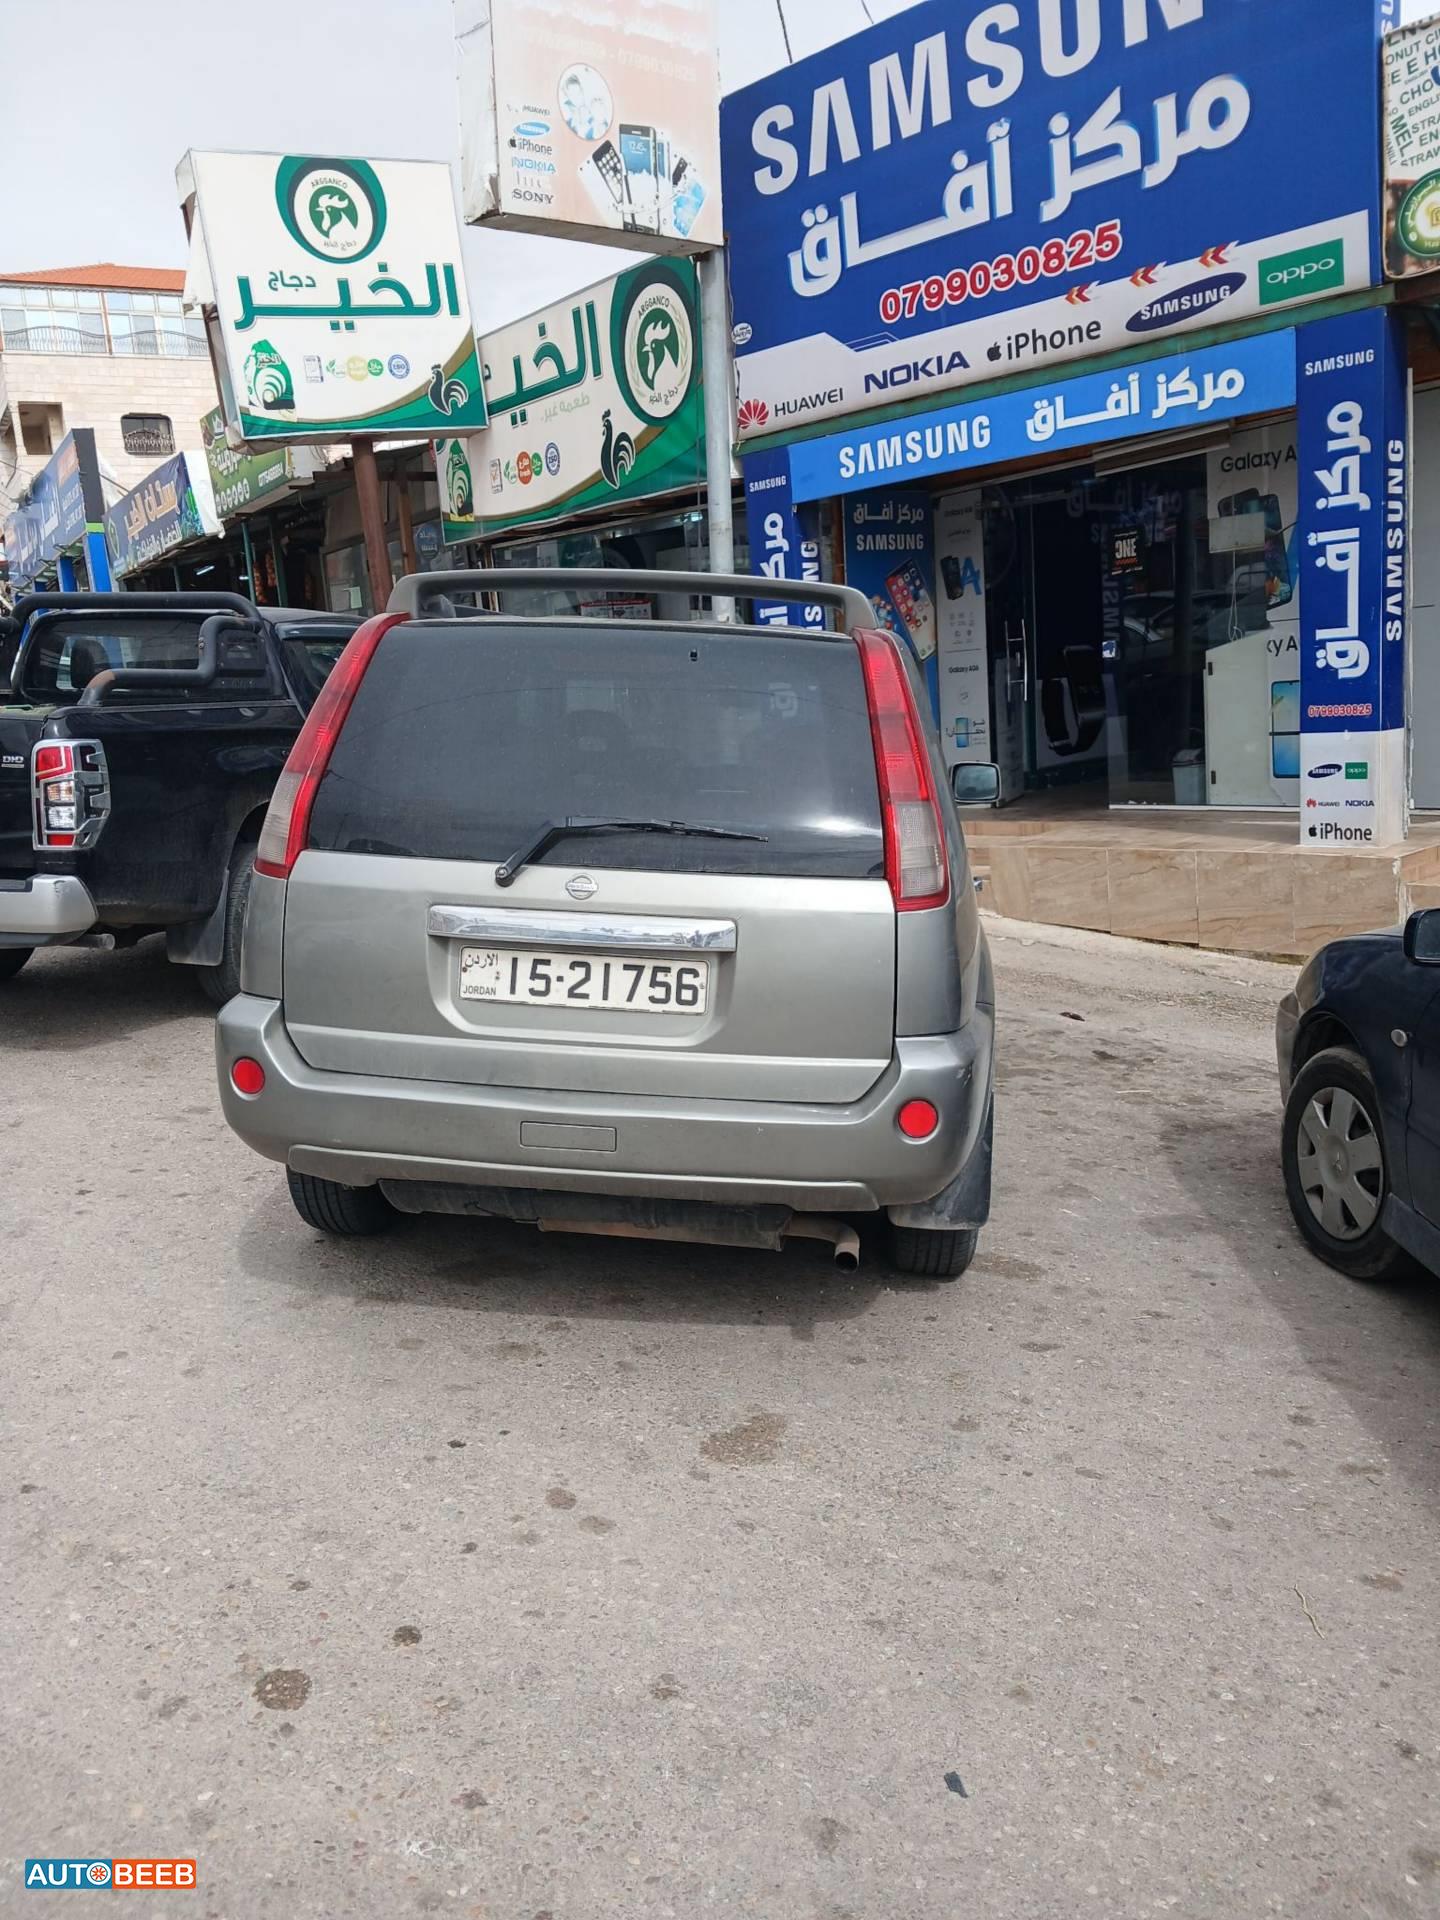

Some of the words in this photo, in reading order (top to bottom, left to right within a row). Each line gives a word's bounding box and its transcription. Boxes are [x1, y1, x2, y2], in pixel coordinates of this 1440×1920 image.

[518, 138, 553, 155] iPhone
[1039, 73, 1251, 224] مركز
[511, 156, 556, 175] NOKIA
[512, 188, 554, 204] SONY
[267, 271, 317, 292] دجاج
[880, 219, 1123, 323] 0799030825
[774, 387, 844, 417] HUAWEI
[863, 350, 970, 393] NOKIA
[1006, 320, 1102, 361] iPhone
[1140, 284, 1231, 321] SAMSUNG
[1265, 256, 1336, 285] oppo
[487, 299, 602, 428] الخي
[1305, 348, 1375, 376] SAMSUNG
[1152, 366, 1246, 420] مركز
[839, 415, 991, 479] SAMSUNG
[1313, 400, 1372, 512] مركز
[1220, 449, 1283, 474] Galaxy
[749, 475, 787, 492] SAMSUNG
[896, 503, 925, 524] مركز
[856, 533, 924, 551] SAMSUNG
[1386, 439, 1405, 642] SAMSUNG
[1307, 703, 1373, 718] 0799030825
[1319, 822, 1373, 841] iPhone
[463, 985, 497, 996] JORDAN
[508, 956, 701, 1007] 15-21756
